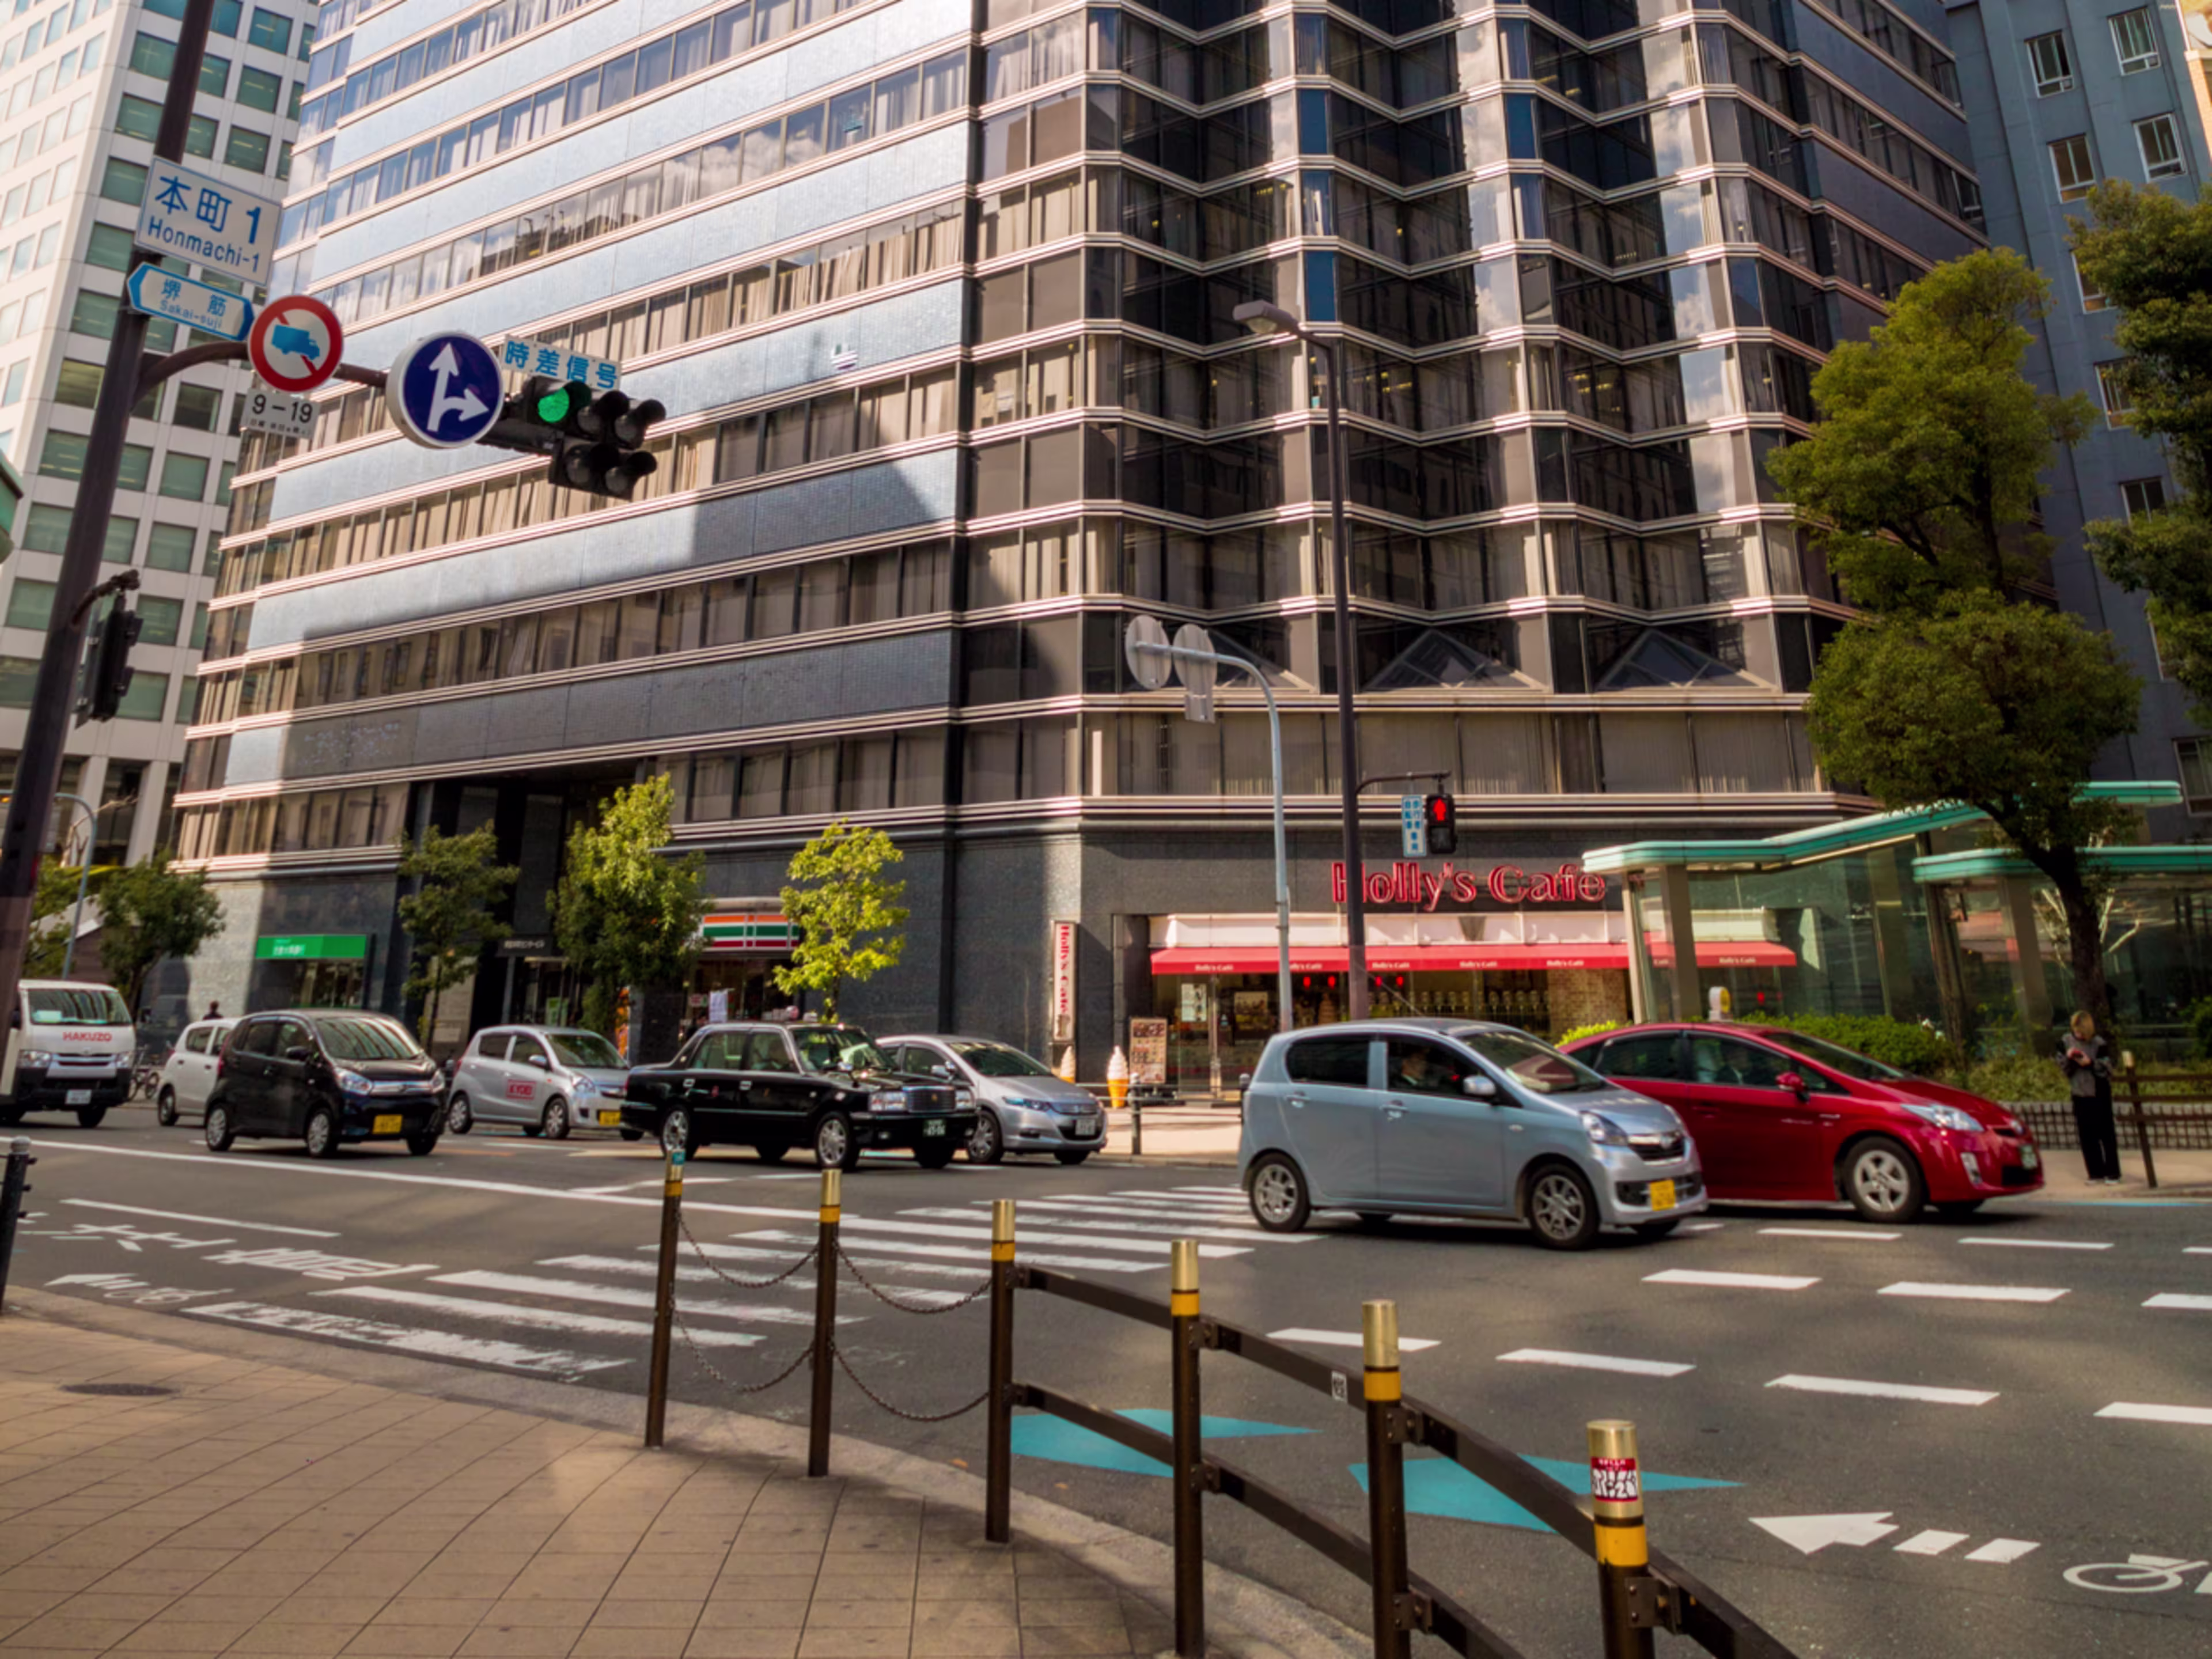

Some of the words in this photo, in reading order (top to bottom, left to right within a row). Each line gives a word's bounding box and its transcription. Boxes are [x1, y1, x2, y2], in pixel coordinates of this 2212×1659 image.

[147, 215, 260, 273] Honmachi-1
[505, 340, 618, 389] 時差信号
[1331, 862, 1477, 912] Holly's
[63, 1032, 112, 1041] HAKUZO
